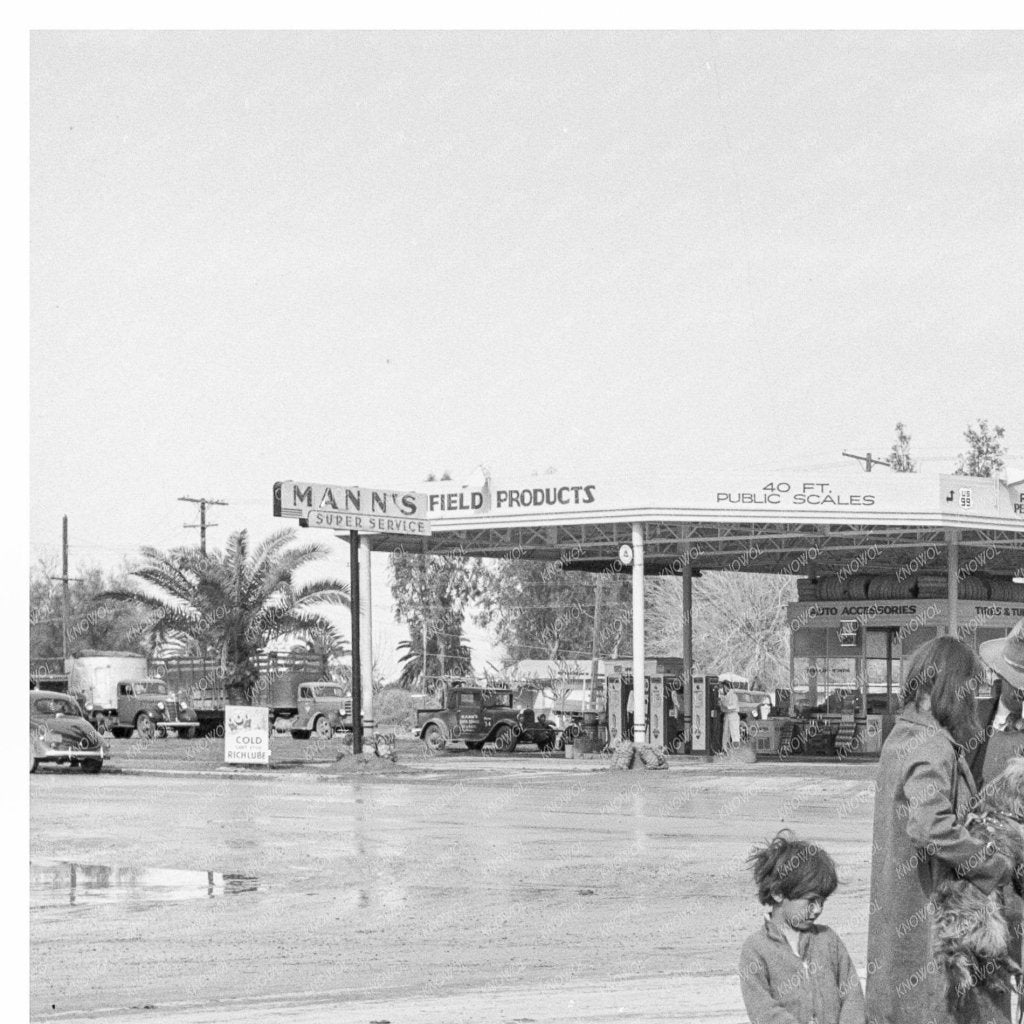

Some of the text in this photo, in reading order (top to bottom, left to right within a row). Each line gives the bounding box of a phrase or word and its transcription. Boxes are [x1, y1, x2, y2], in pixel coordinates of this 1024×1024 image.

[762, 482, 833, 494] 40 FT.
[293, 485, 418, 516] MANN'S
[496, 485, 596, 508] PRODUCTS
[716, 493, 875, 506] PUBLIC SCALES
[315, 514, 426, 533] SUPER SERVICE
[810, 605, 917, 616] AUTO ACCESSORIES
[236, 736, 262, 745] COLD
[228, 751, 266, 759] RICHLUBE
